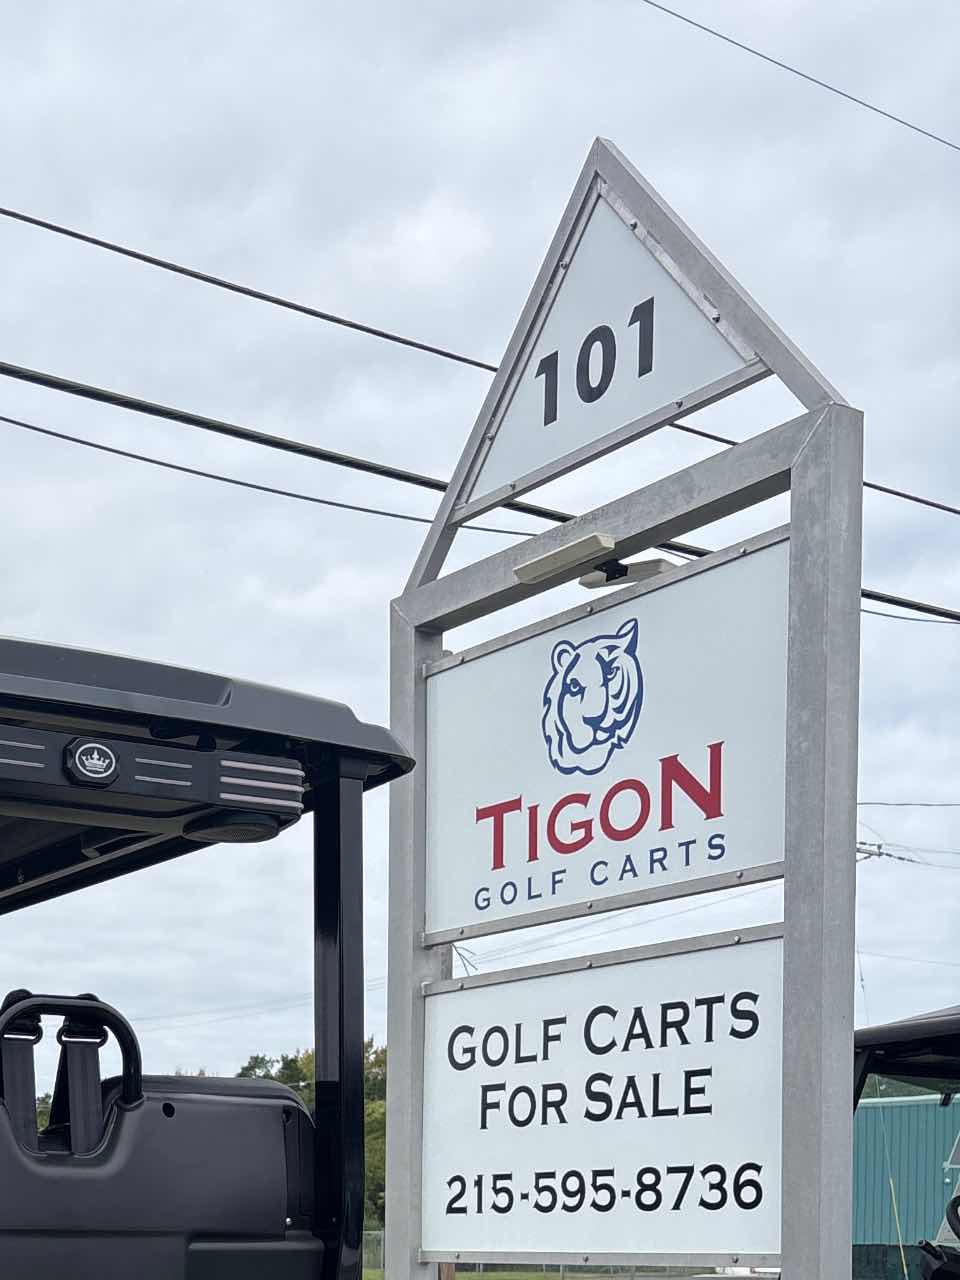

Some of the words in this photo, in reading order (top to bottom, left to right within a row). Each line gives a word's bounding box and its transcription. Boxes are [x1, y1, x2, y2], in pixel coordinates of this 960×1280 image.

[535, 296, 654, 427] 101
[475, 741, 725, 871] TIGON
[474, 868, 567, 911] GOLF
[589, 833, 727, 886] CARTS
[447, 1016, 567, 1071] GOLF
[583, 991, 760, 1056] CARTS
[479, 1082, 568, 1130] FOR
[584, 1065, 713, 1122] SALE
[445, 1162, 764, 1216] 215-595-8736
